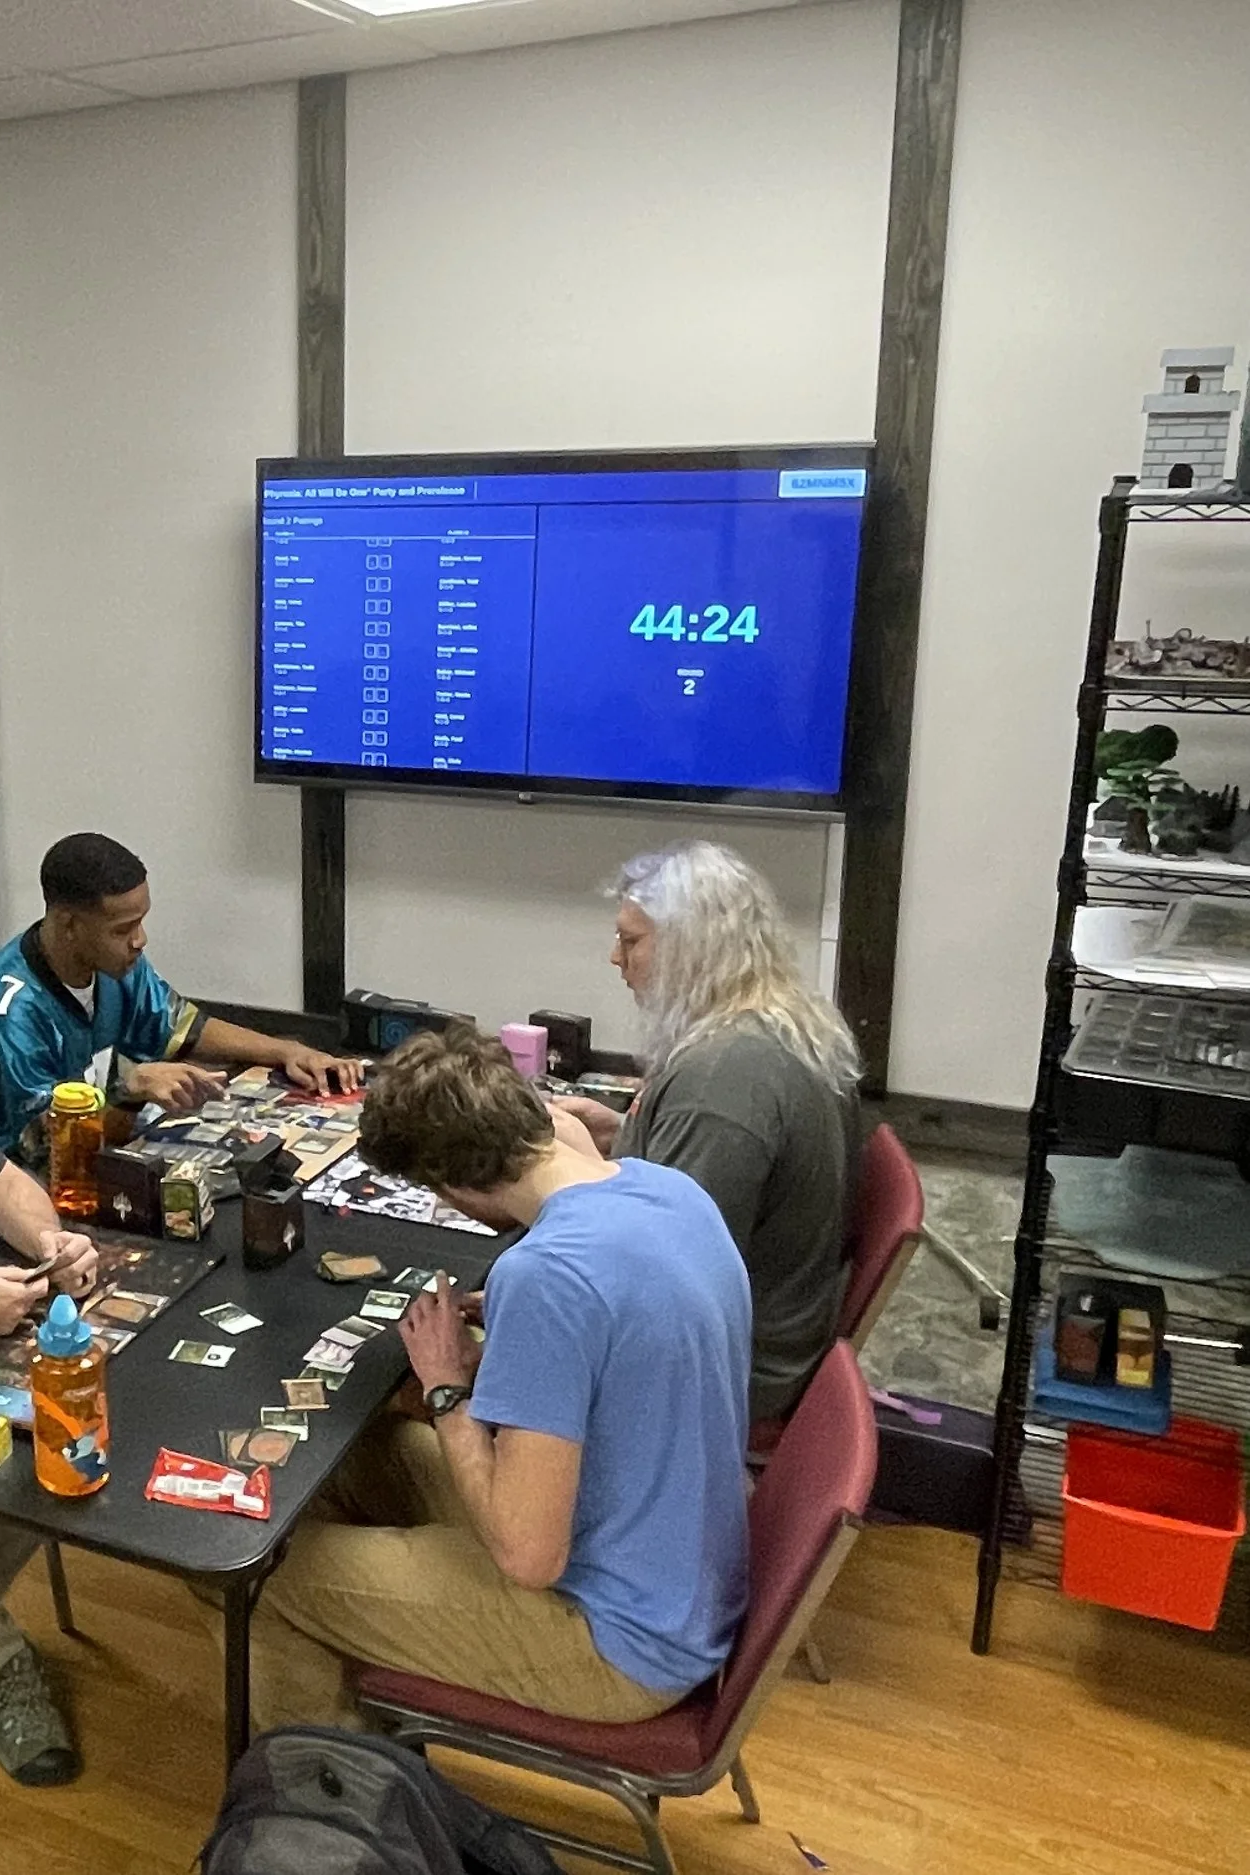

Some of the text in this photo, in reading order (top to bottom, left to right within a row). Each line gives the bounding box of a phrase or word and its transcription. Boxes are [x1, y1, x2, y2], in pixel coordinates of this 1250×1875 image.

[372, 487, 397, 498] Party
[398, 486, 416, 497] and
[630, 604, 760, 643] 44:24
[683, 679, 696, 695] 2
